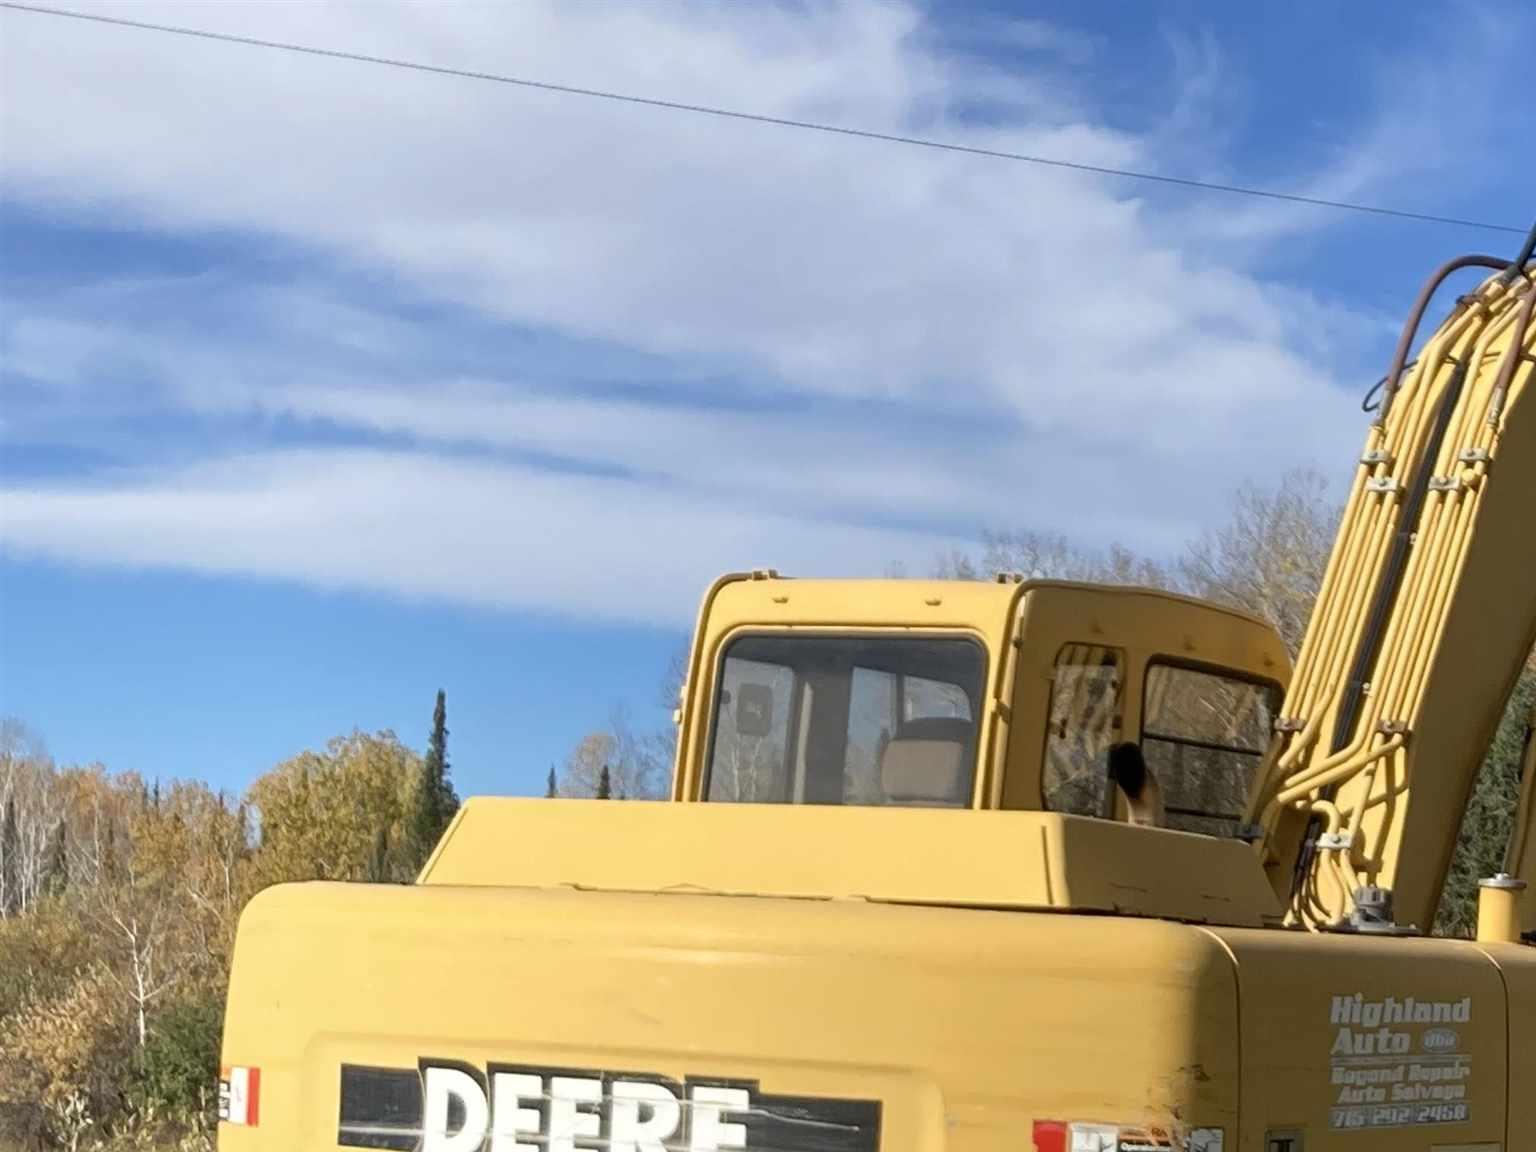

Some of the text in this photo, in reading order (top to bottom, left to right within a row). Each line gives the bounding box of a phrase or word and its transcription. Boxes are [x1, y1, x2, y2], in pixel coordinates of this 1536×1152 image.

[1330, 992, 1471, 1027] Highland
[1330, 1027, 1411, 1055] Auto
[1330, 1061, 1470, 1086] Beyond Repair
[1337, 1083, 1466, 1104] Auto Salvage
[1416, 1104, 1467, 1122] 2458
